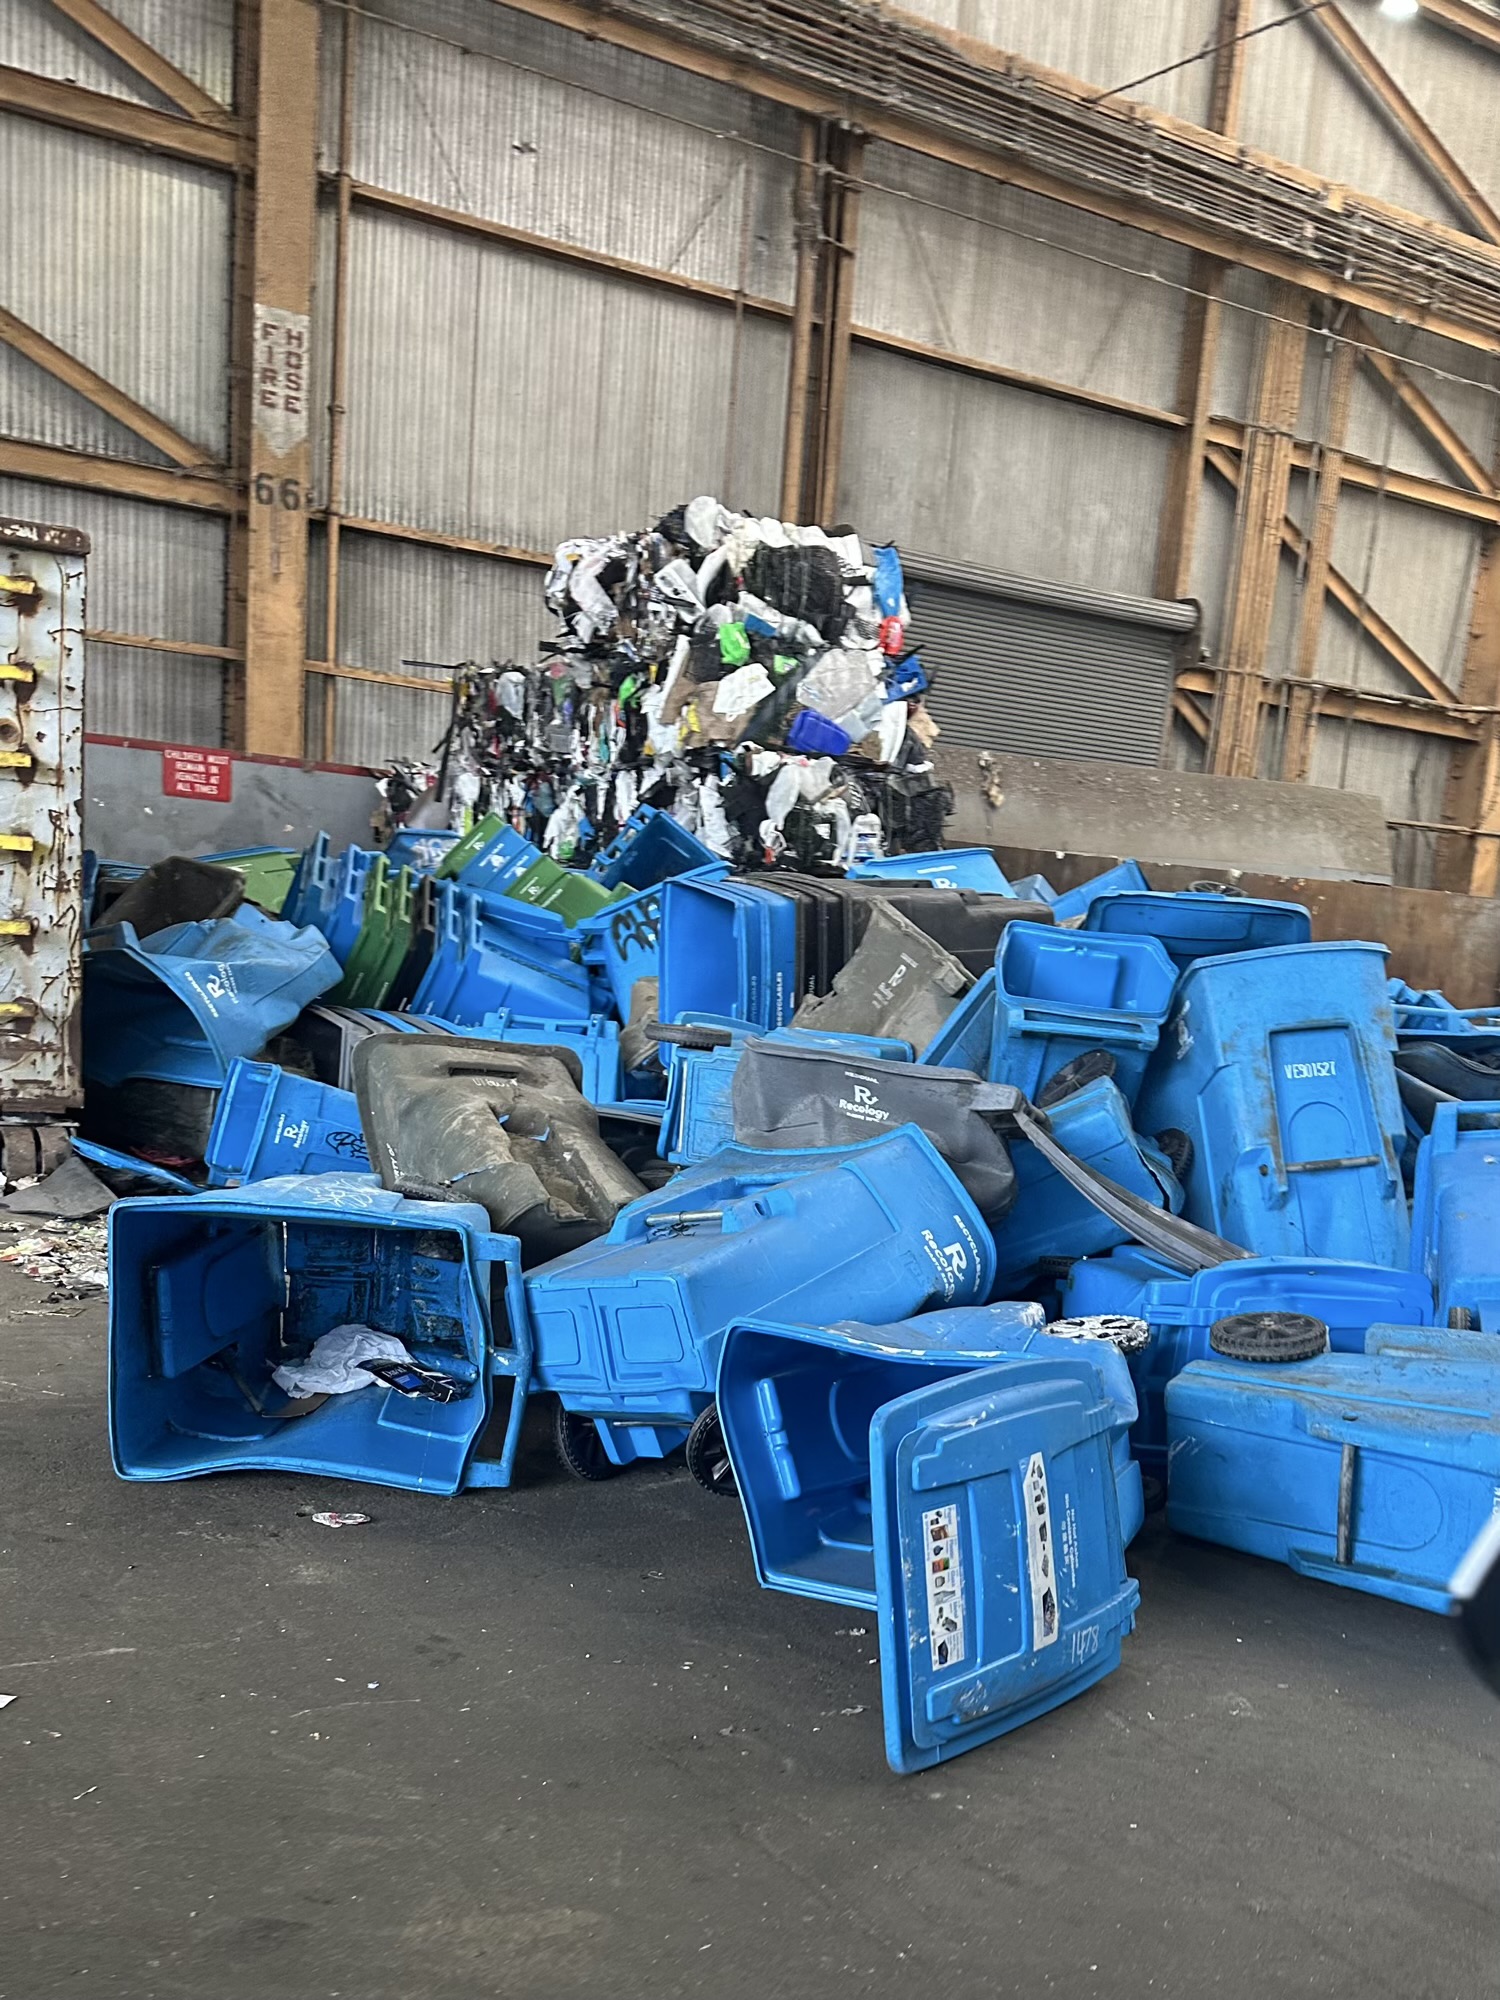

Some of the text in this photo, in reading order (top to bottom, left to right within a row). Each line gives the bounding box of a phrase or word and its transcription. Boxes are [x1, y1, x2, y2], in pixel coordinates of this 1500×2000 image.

[260, 322, 278, 409] FIRE
[284, 328, 304, 415] HOSE
[255, 471, 300, 511] 66
[164, 749, 204, 762] CHILDREN
[175, 761, 206, 773] REMAIN
[175, 772, 208, 784] VEHICLE
[176, 782, 219, 795] ALL TIMES
[839, 1098, 890, 1121] Recology
[921, 1229, 956, 1302] Recology
[943, 1242, 967, 1282] R
[953, 1214, 981, 1293] RECYCLABLES
